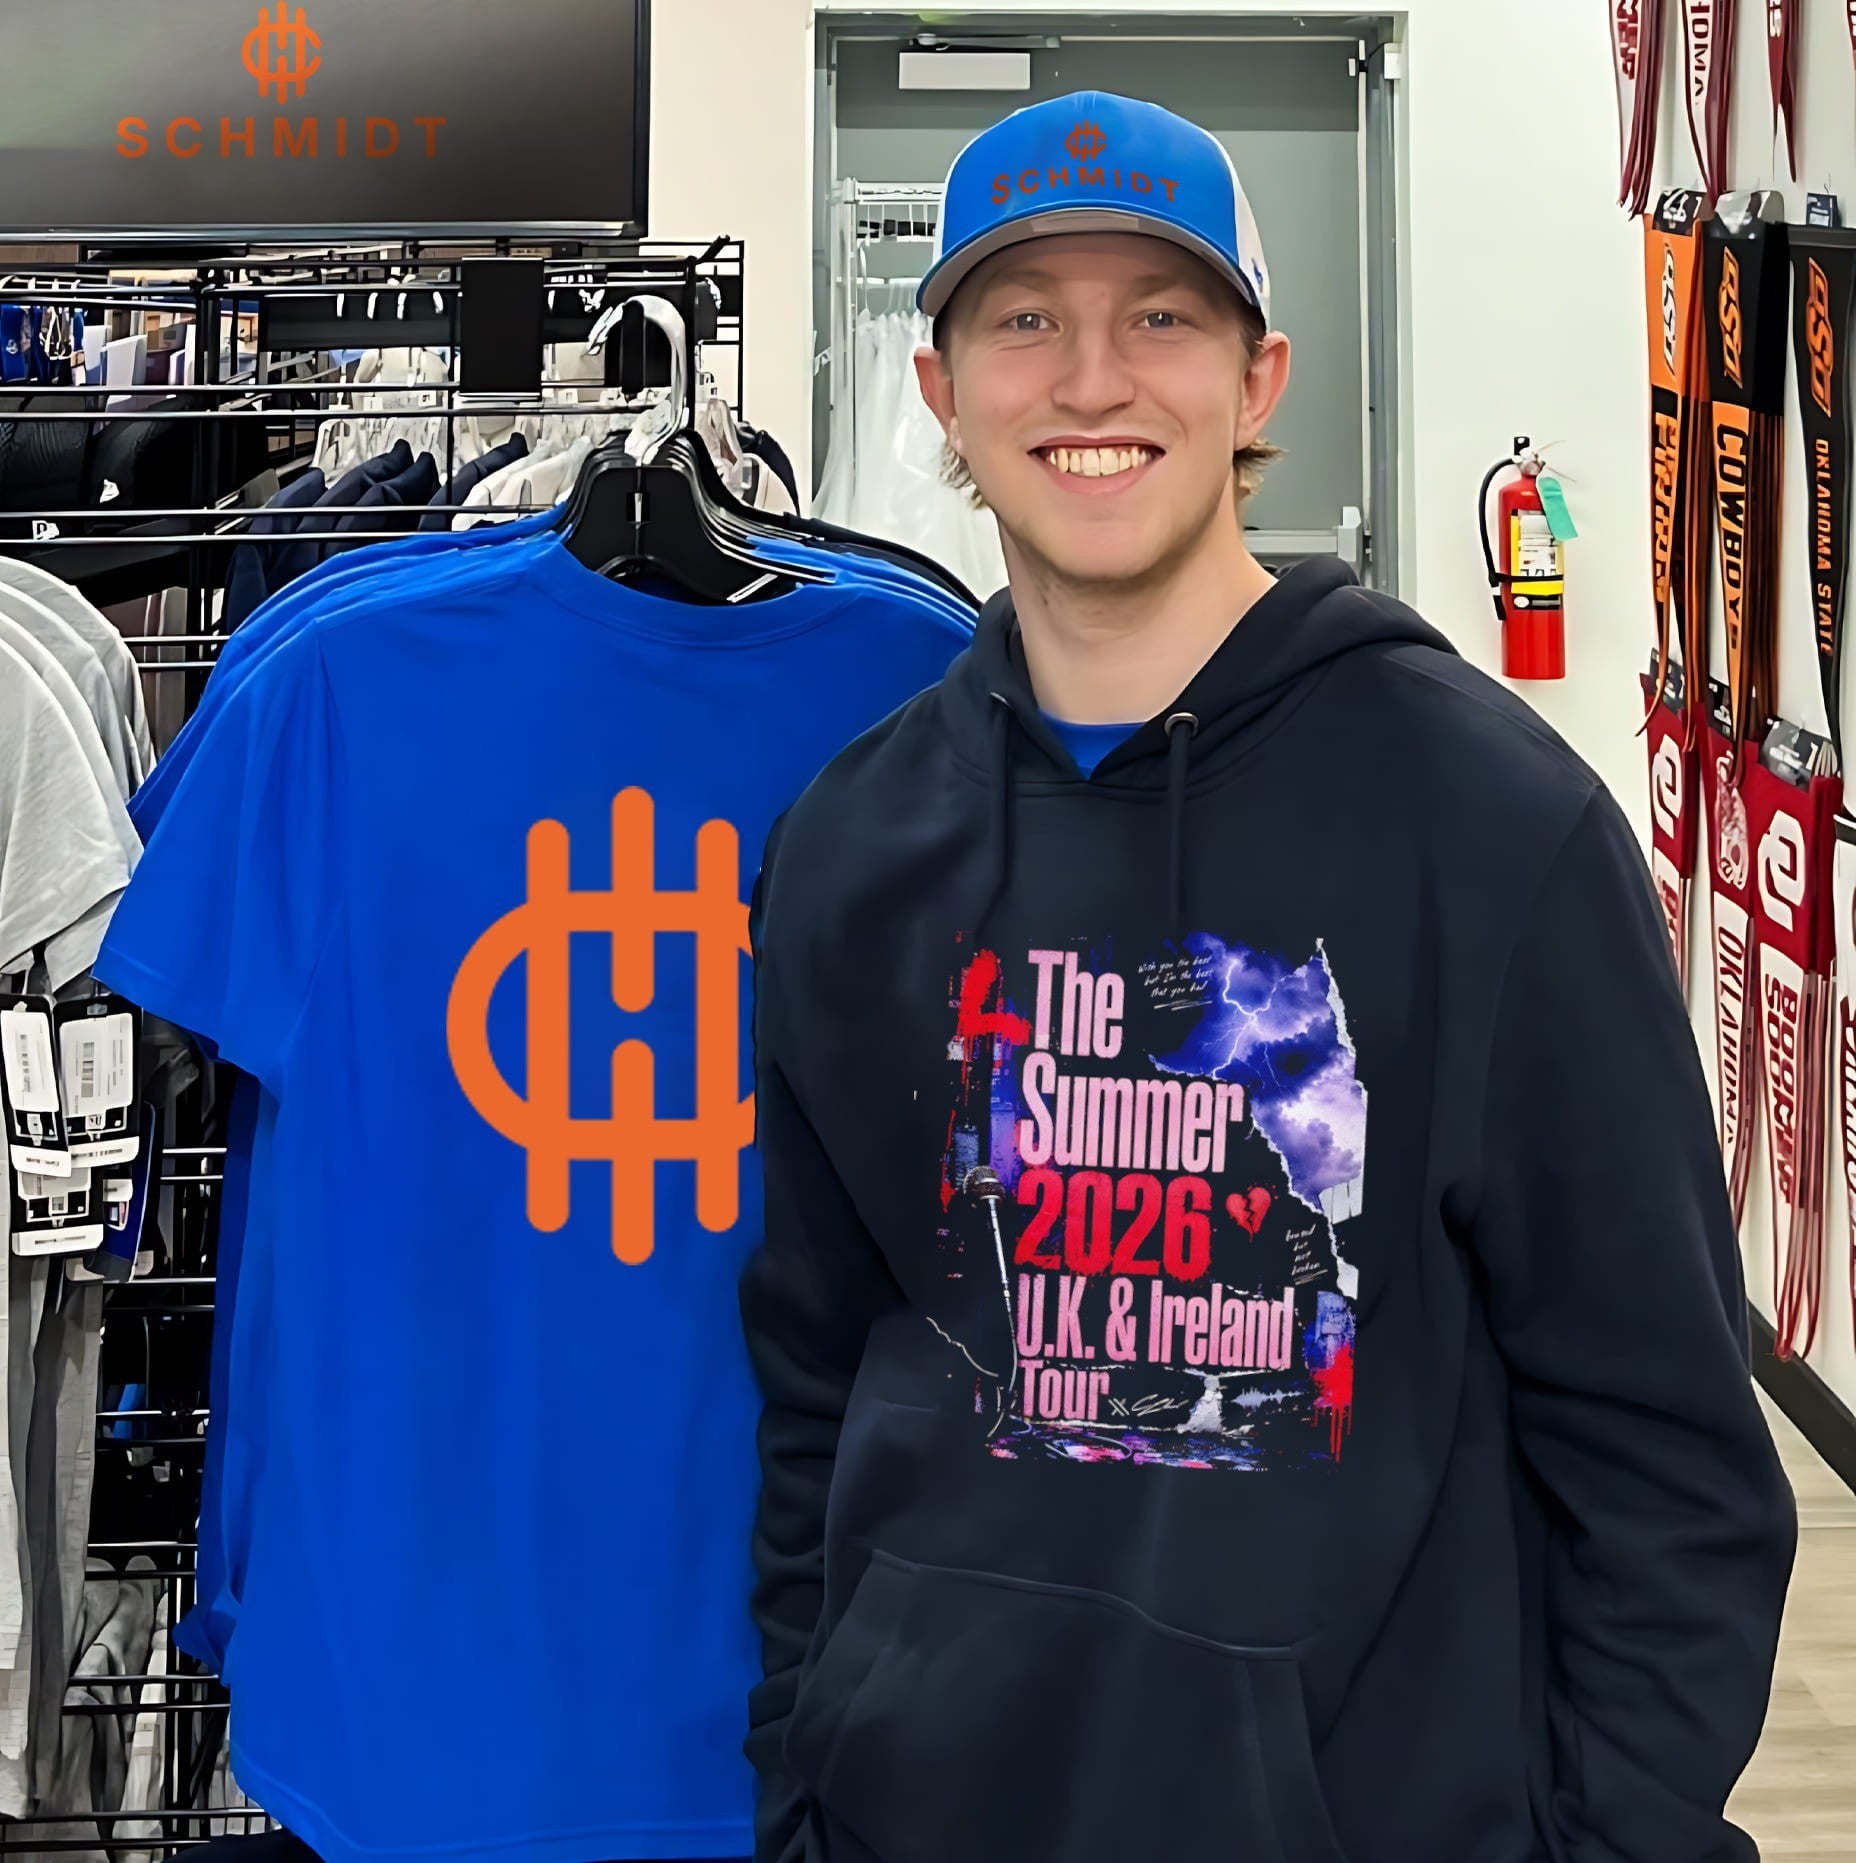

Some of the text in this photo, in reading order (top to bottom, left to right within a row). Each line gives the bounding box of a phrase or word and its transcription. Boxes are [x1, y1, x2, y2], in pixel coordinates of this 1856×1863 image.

[115, 116, 449, 159] SCHMIDT
[991, 167, 1179, 204] SCHMIDT
[1815, 438, 1833, 571] OKLAHOMA
[1028, 949, 1125, 1058] The
[1019, 1052, 1245, 1173] Summer
[1014, 1168, 1213, 1282] 2026
[1016, 1273, 1296, 1370] U.K. & Ireland
[1018, 1358, 1111, 1422] Tour
